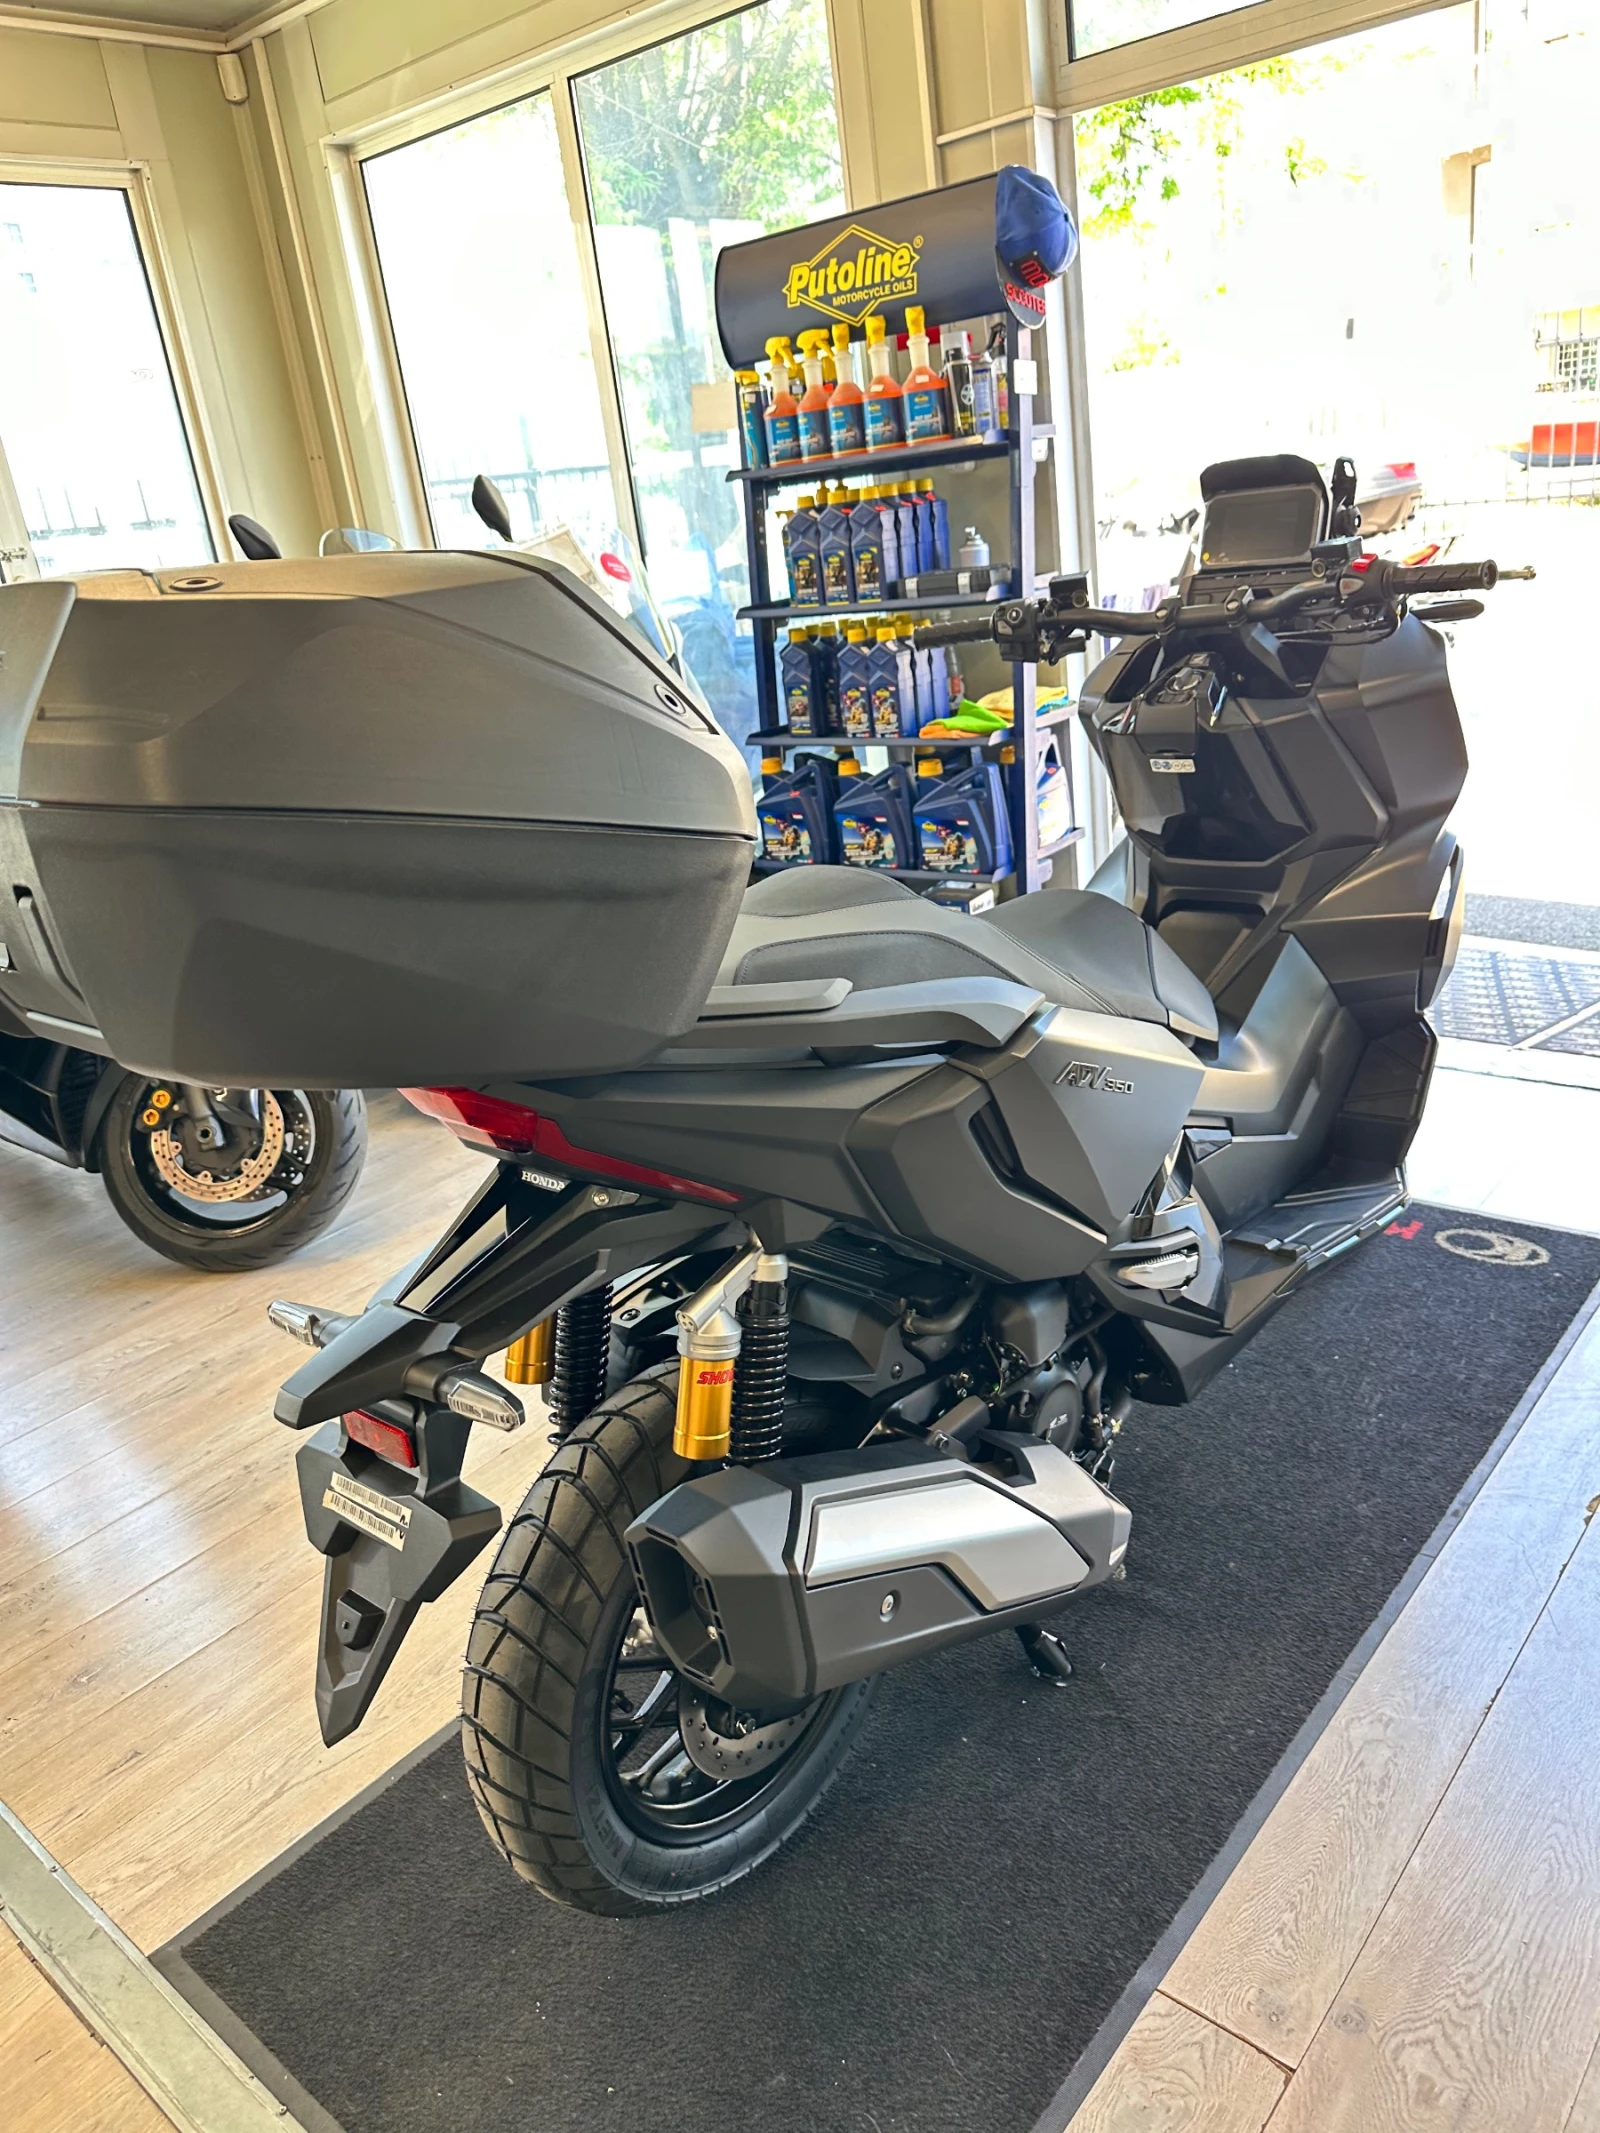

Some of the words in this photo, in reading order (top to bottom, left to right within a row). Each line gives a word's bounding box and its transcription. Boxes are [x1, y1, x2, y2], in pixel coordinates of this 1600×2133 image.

[1020, 260, 1051, 288] MO
[832, 285, 891, 307] MOTORCYCLE
[892, 279, 913, 293] OILS
[521, 1170, 565, 1191] HONDA
